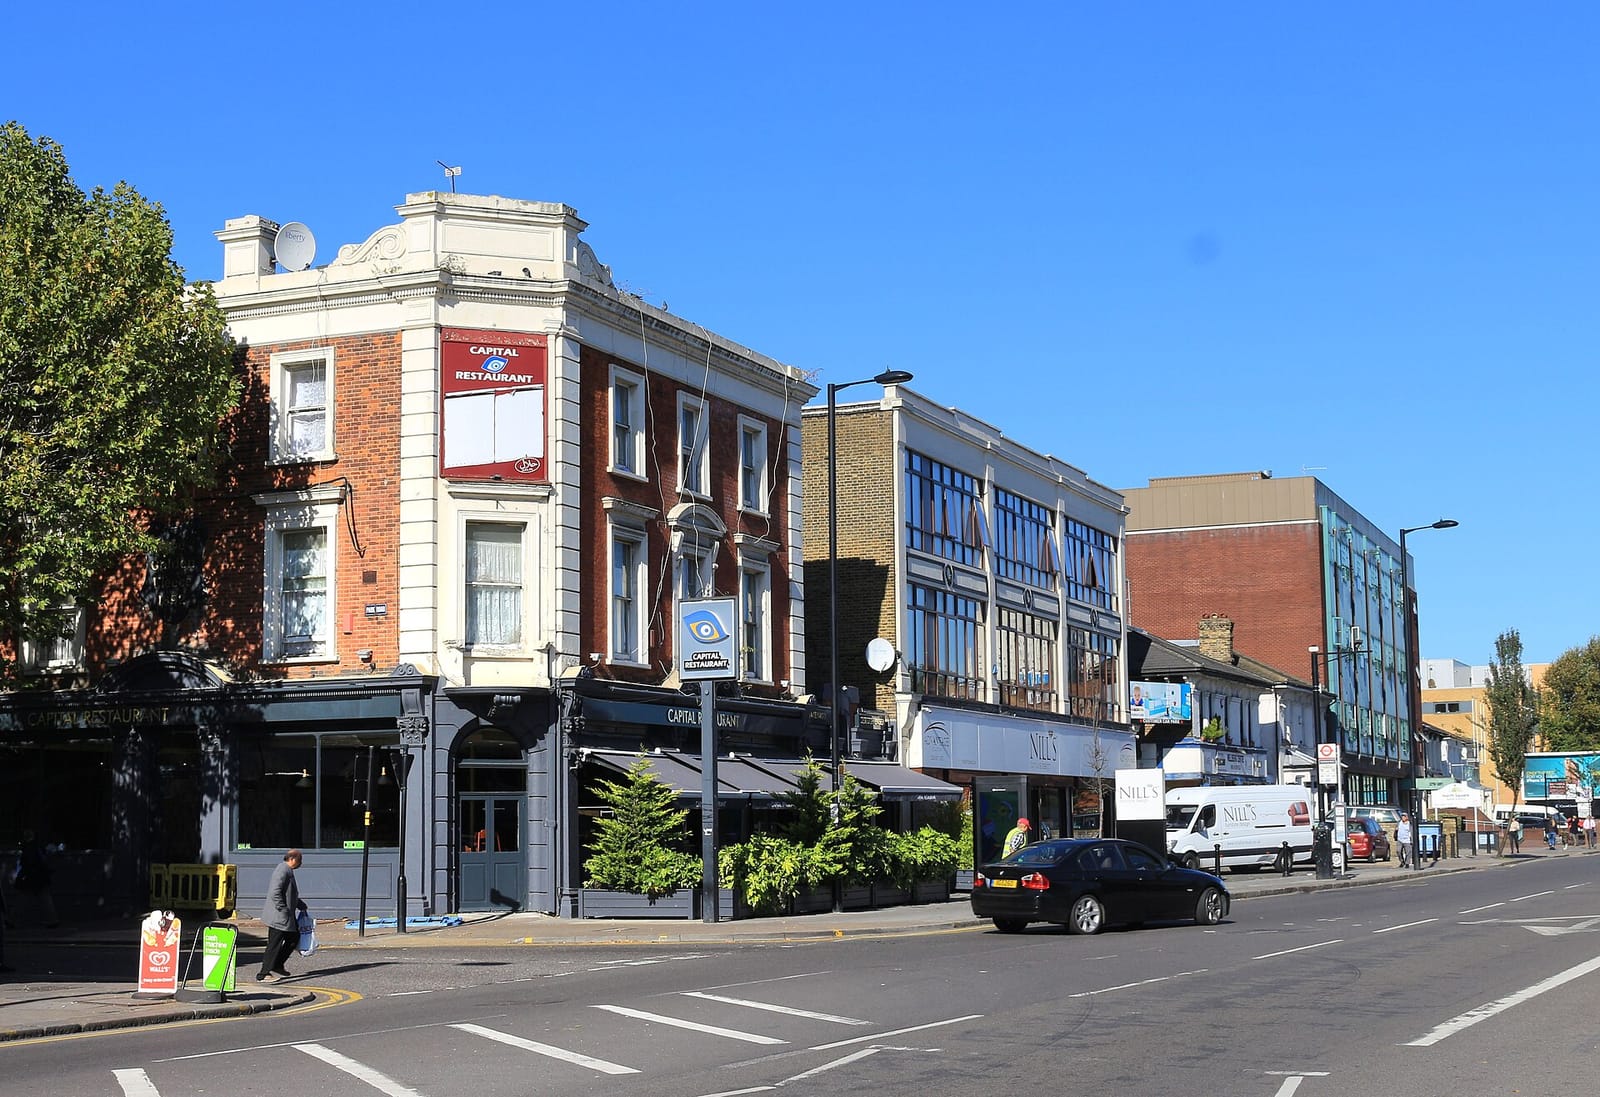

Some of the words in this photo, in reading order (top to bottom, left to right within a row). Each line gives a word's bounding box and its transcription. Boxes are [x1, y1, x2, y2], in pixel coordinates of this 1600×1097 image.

[469, 346, 519, 357] CAPITAL
[455, 371, 533, 383] RESTAURANT
[692, 652, 720, 660] CAPITAL
[684, 660, 728, 668] RESTAURANT
[27, 711, 77, 726] CAPITAL
[84, 707, 169, 725] RESTAURANT
[667, 708, 697, 724] CAPITAL
[697, 711, 740, 728] RURANT
